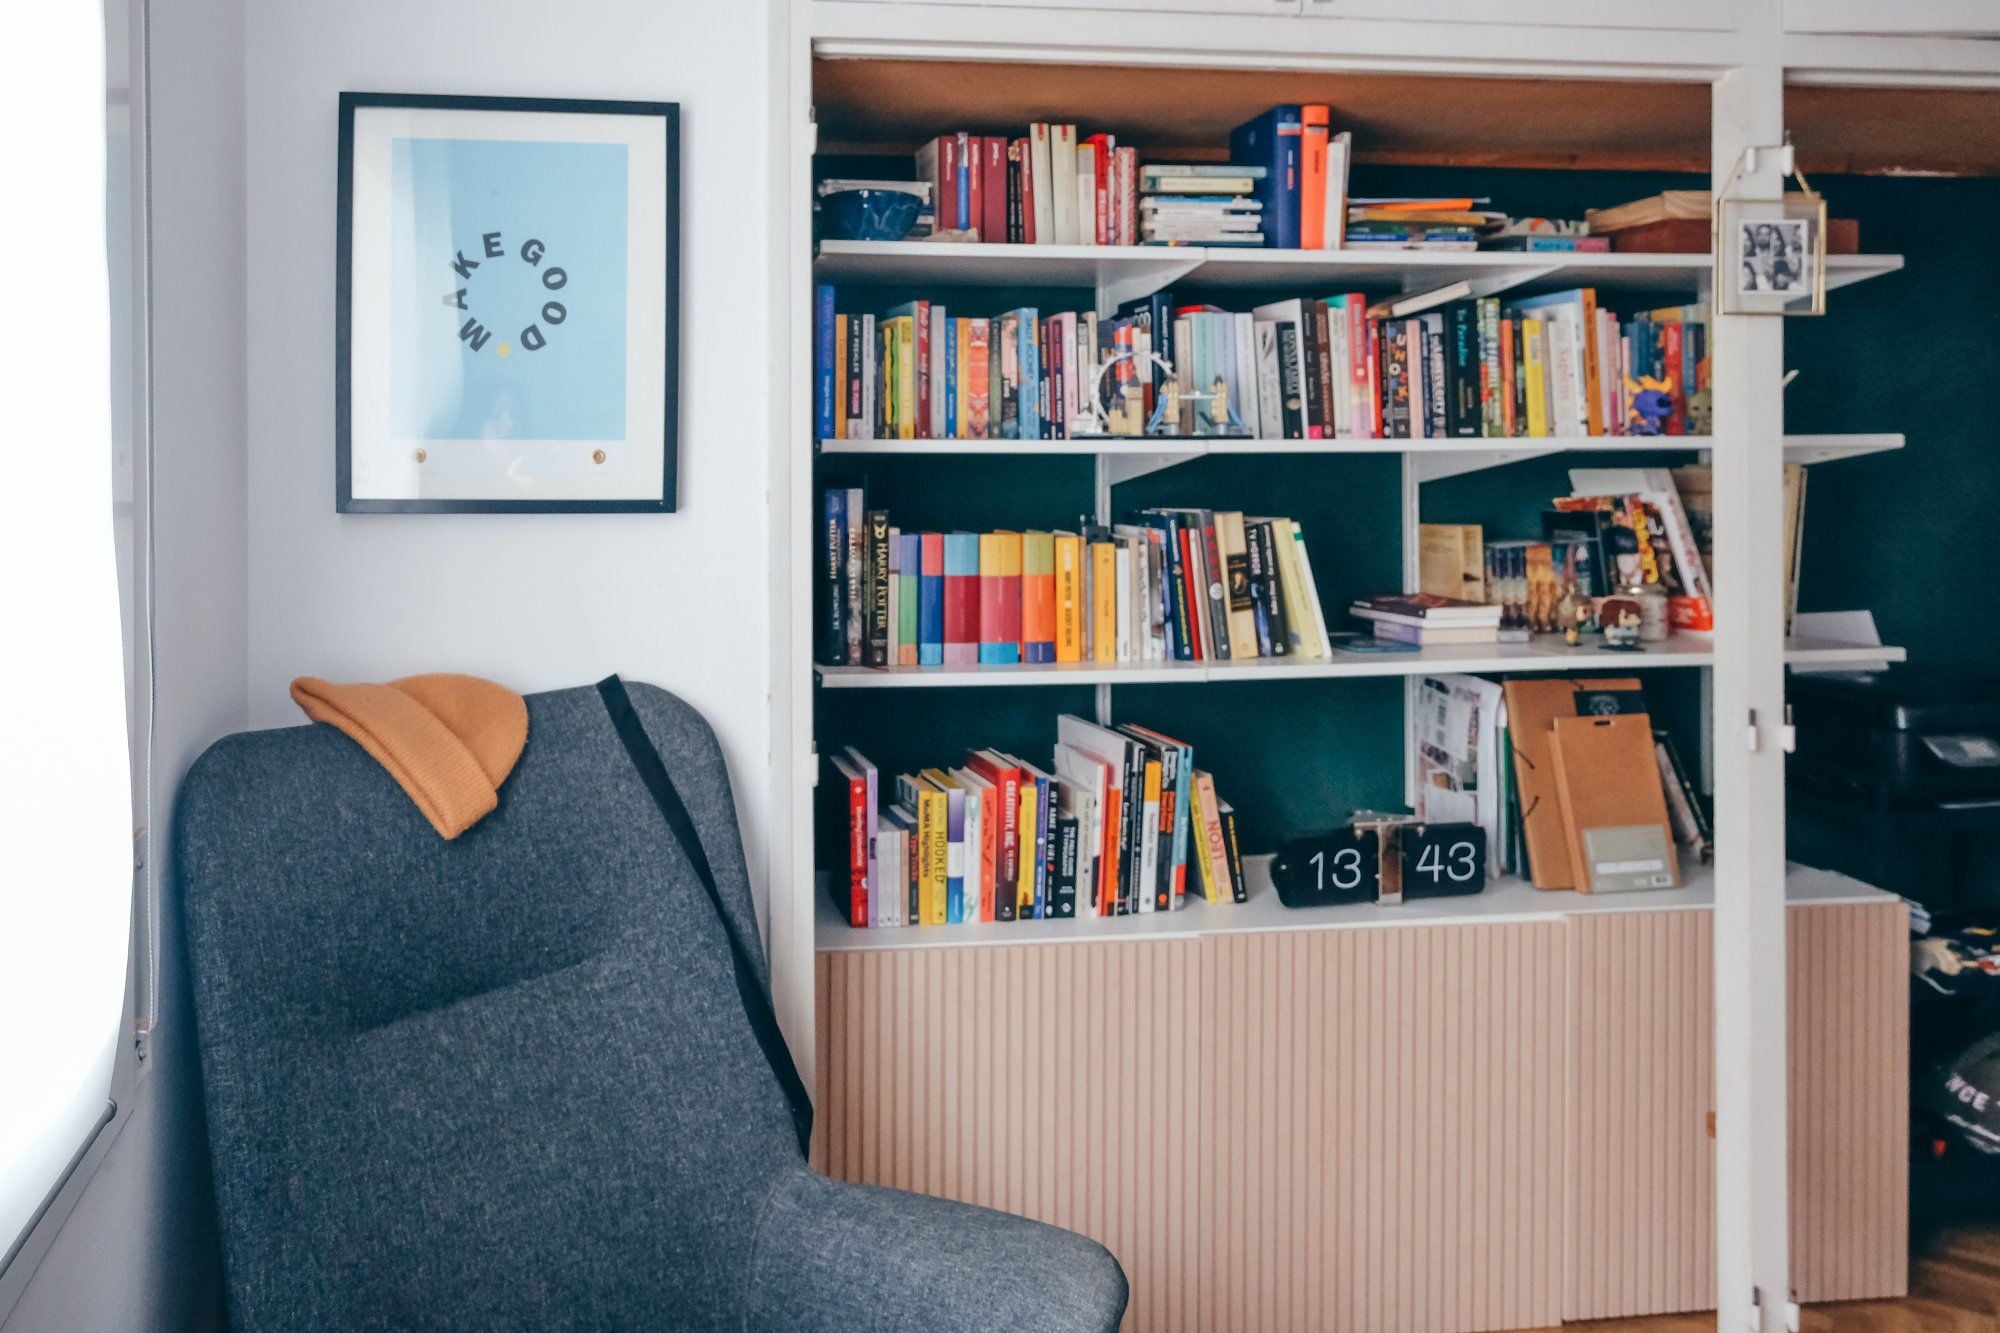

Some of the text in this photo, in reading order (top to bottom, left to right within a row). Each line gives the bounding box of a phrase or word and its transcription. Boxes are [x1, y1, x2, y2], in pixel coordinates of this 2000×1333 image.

[441, 231, 568, 353] MAKE GOOD
[852, 319, 860, 335] AMY
[829, 518, 838, 579] HARRY POTTER
[876, 543, 888, 631] HARRY POTTER
[921, 799, 931, 878] MoMA Highlights
[1003, 780, 1016, 849] CREATIVITY, INC.
[1206, 819, 1224, 861] LEON
[934, 831, 945, 884] HOOKED
[1308, 841, 1476, 890] 13 43
